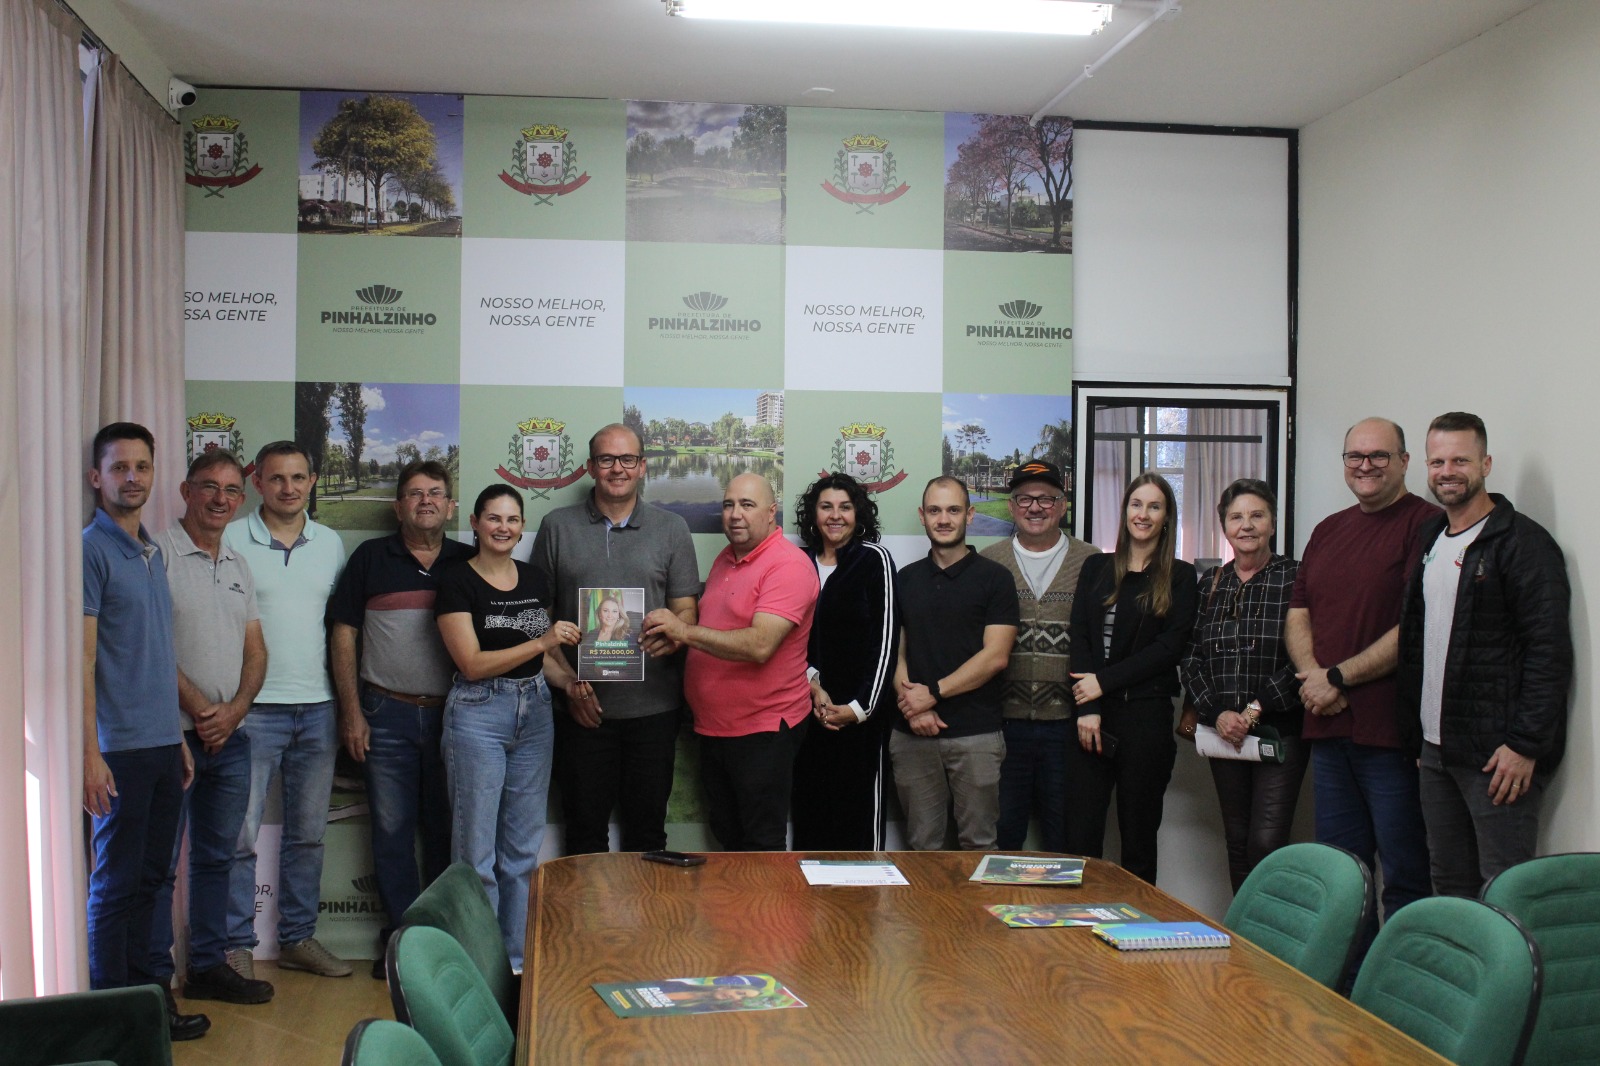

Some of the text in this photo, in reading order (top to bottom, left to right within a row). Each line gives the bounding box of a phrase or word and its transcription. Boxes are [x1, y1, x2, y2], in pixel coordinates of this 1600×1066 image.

[208, 292, 278, 306] MELHOR,
[480, 297, 607, 312] NOSSO MELHOR,
[215, 309, 268, 322] GENTE
[320, 311, 437, 326] PINHALZINHO
[803, 304, 926, 319] NOSSO MELHOR,
[489, 314, 596, 328] NOSSA GENTE
[648, 317, 762, 332] PINHALZINHO
[813, 321, 916, 335] NOSSA GENTE
[966, 325, 1073, 340] PINHALZINHO
